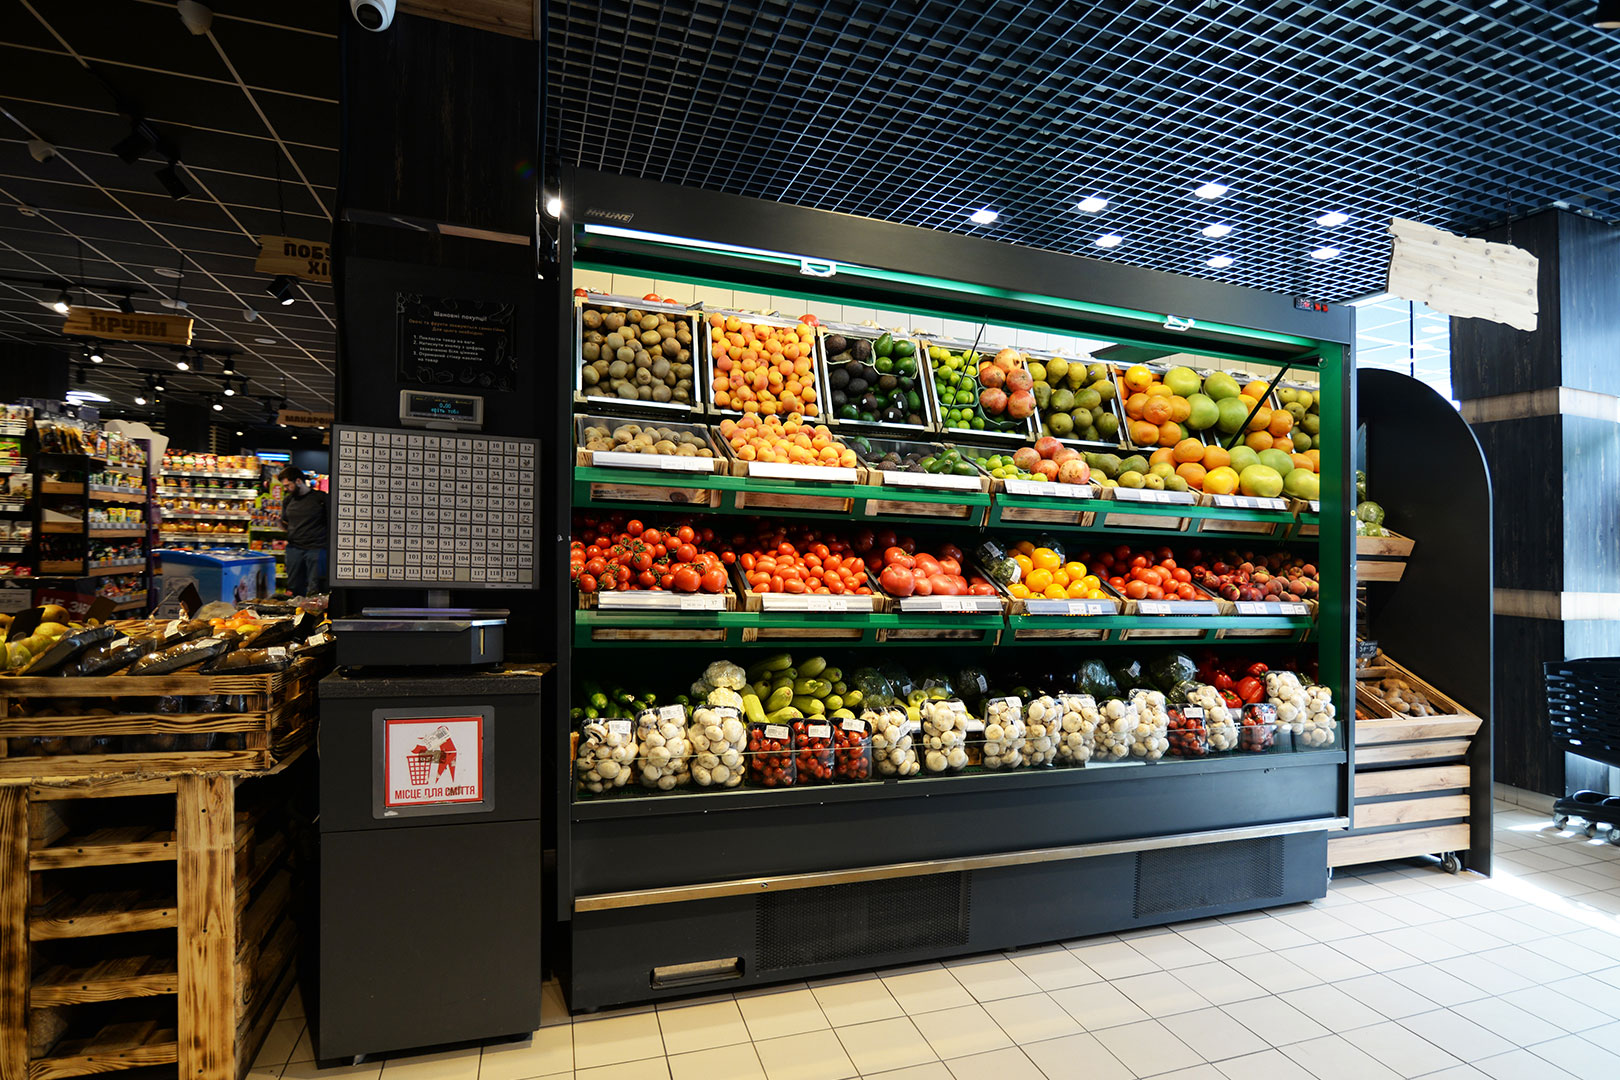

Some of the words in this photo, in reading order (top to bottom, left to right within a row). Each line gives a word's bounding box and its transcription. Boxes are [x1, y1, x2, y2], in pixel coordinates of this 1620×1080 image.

[433, 311, 460, 319] Шановні
[91, 315, 168, 337] КРУПИ
[394, 788, 422, 800] МІСЦЕ
[445, 785, 475, 797] СМІТТЯ
